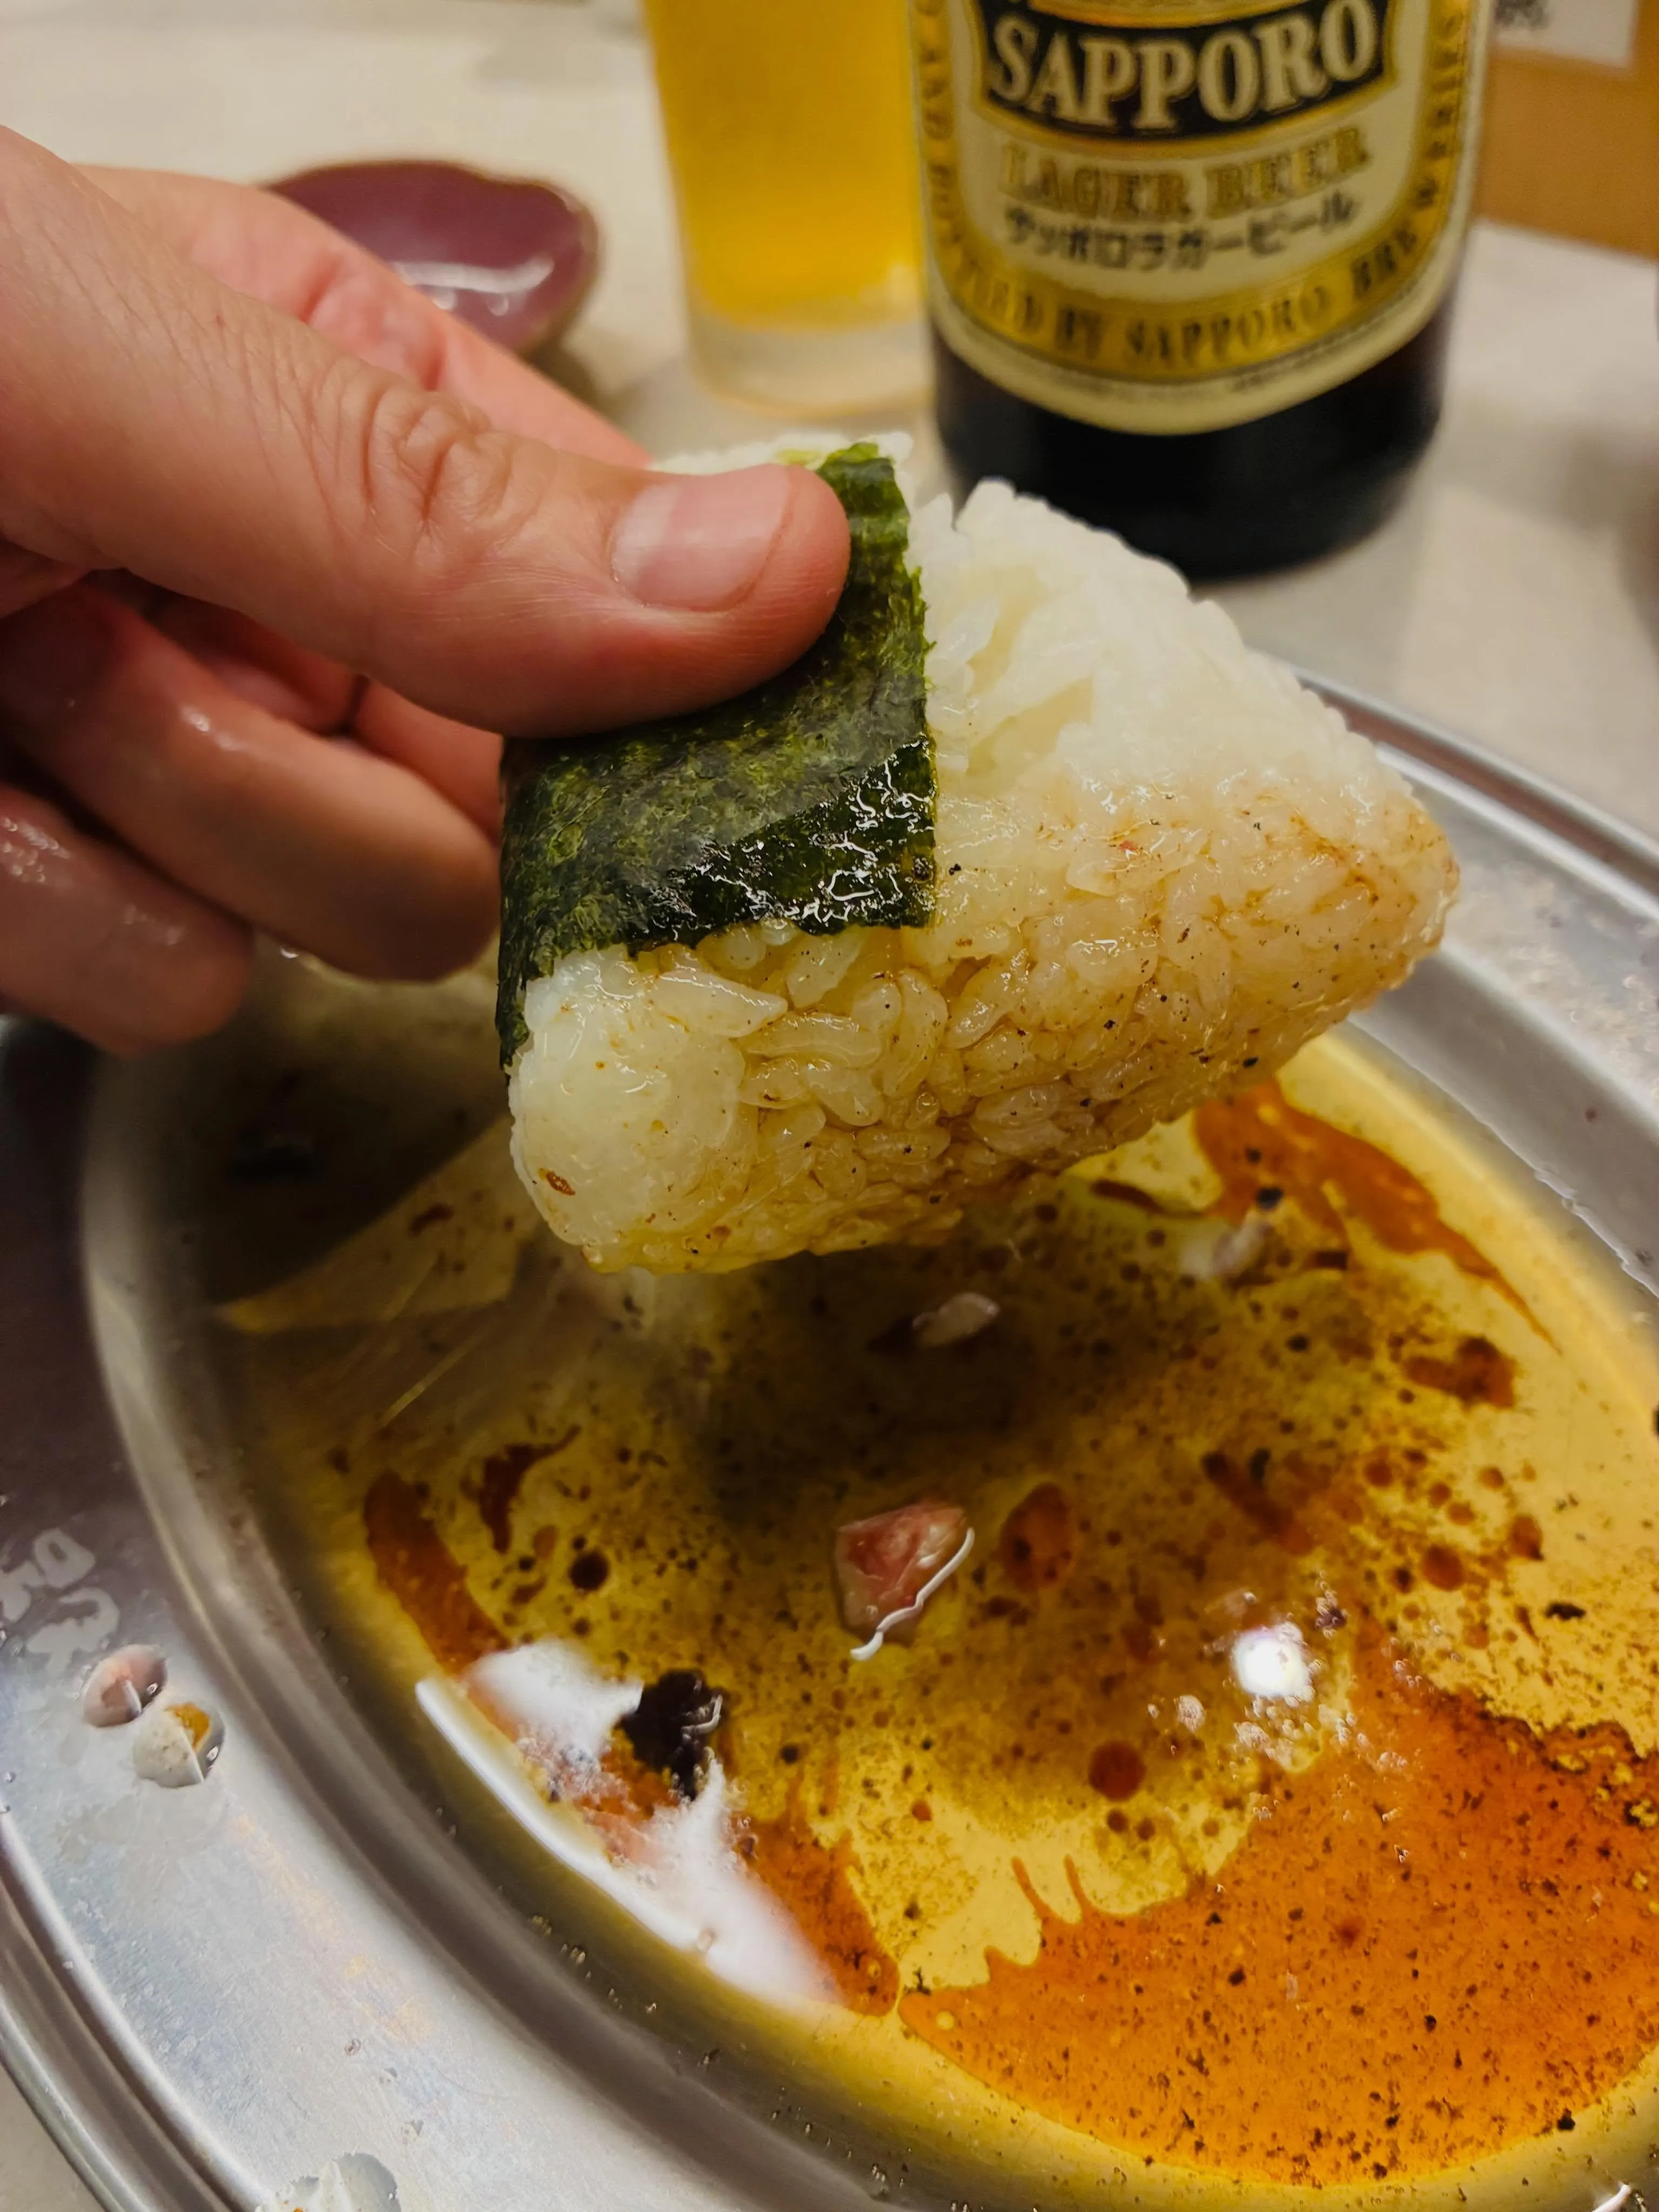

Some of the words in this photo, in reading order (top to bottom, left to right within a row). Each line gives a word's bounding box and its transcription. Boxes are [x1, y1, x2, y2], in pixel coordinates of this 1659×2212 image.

[987, 0, 1378, 131] SAPPORO
[1000, 141, 1195, 222] LAGER
[1203, 127, 1370, 219] BEER
